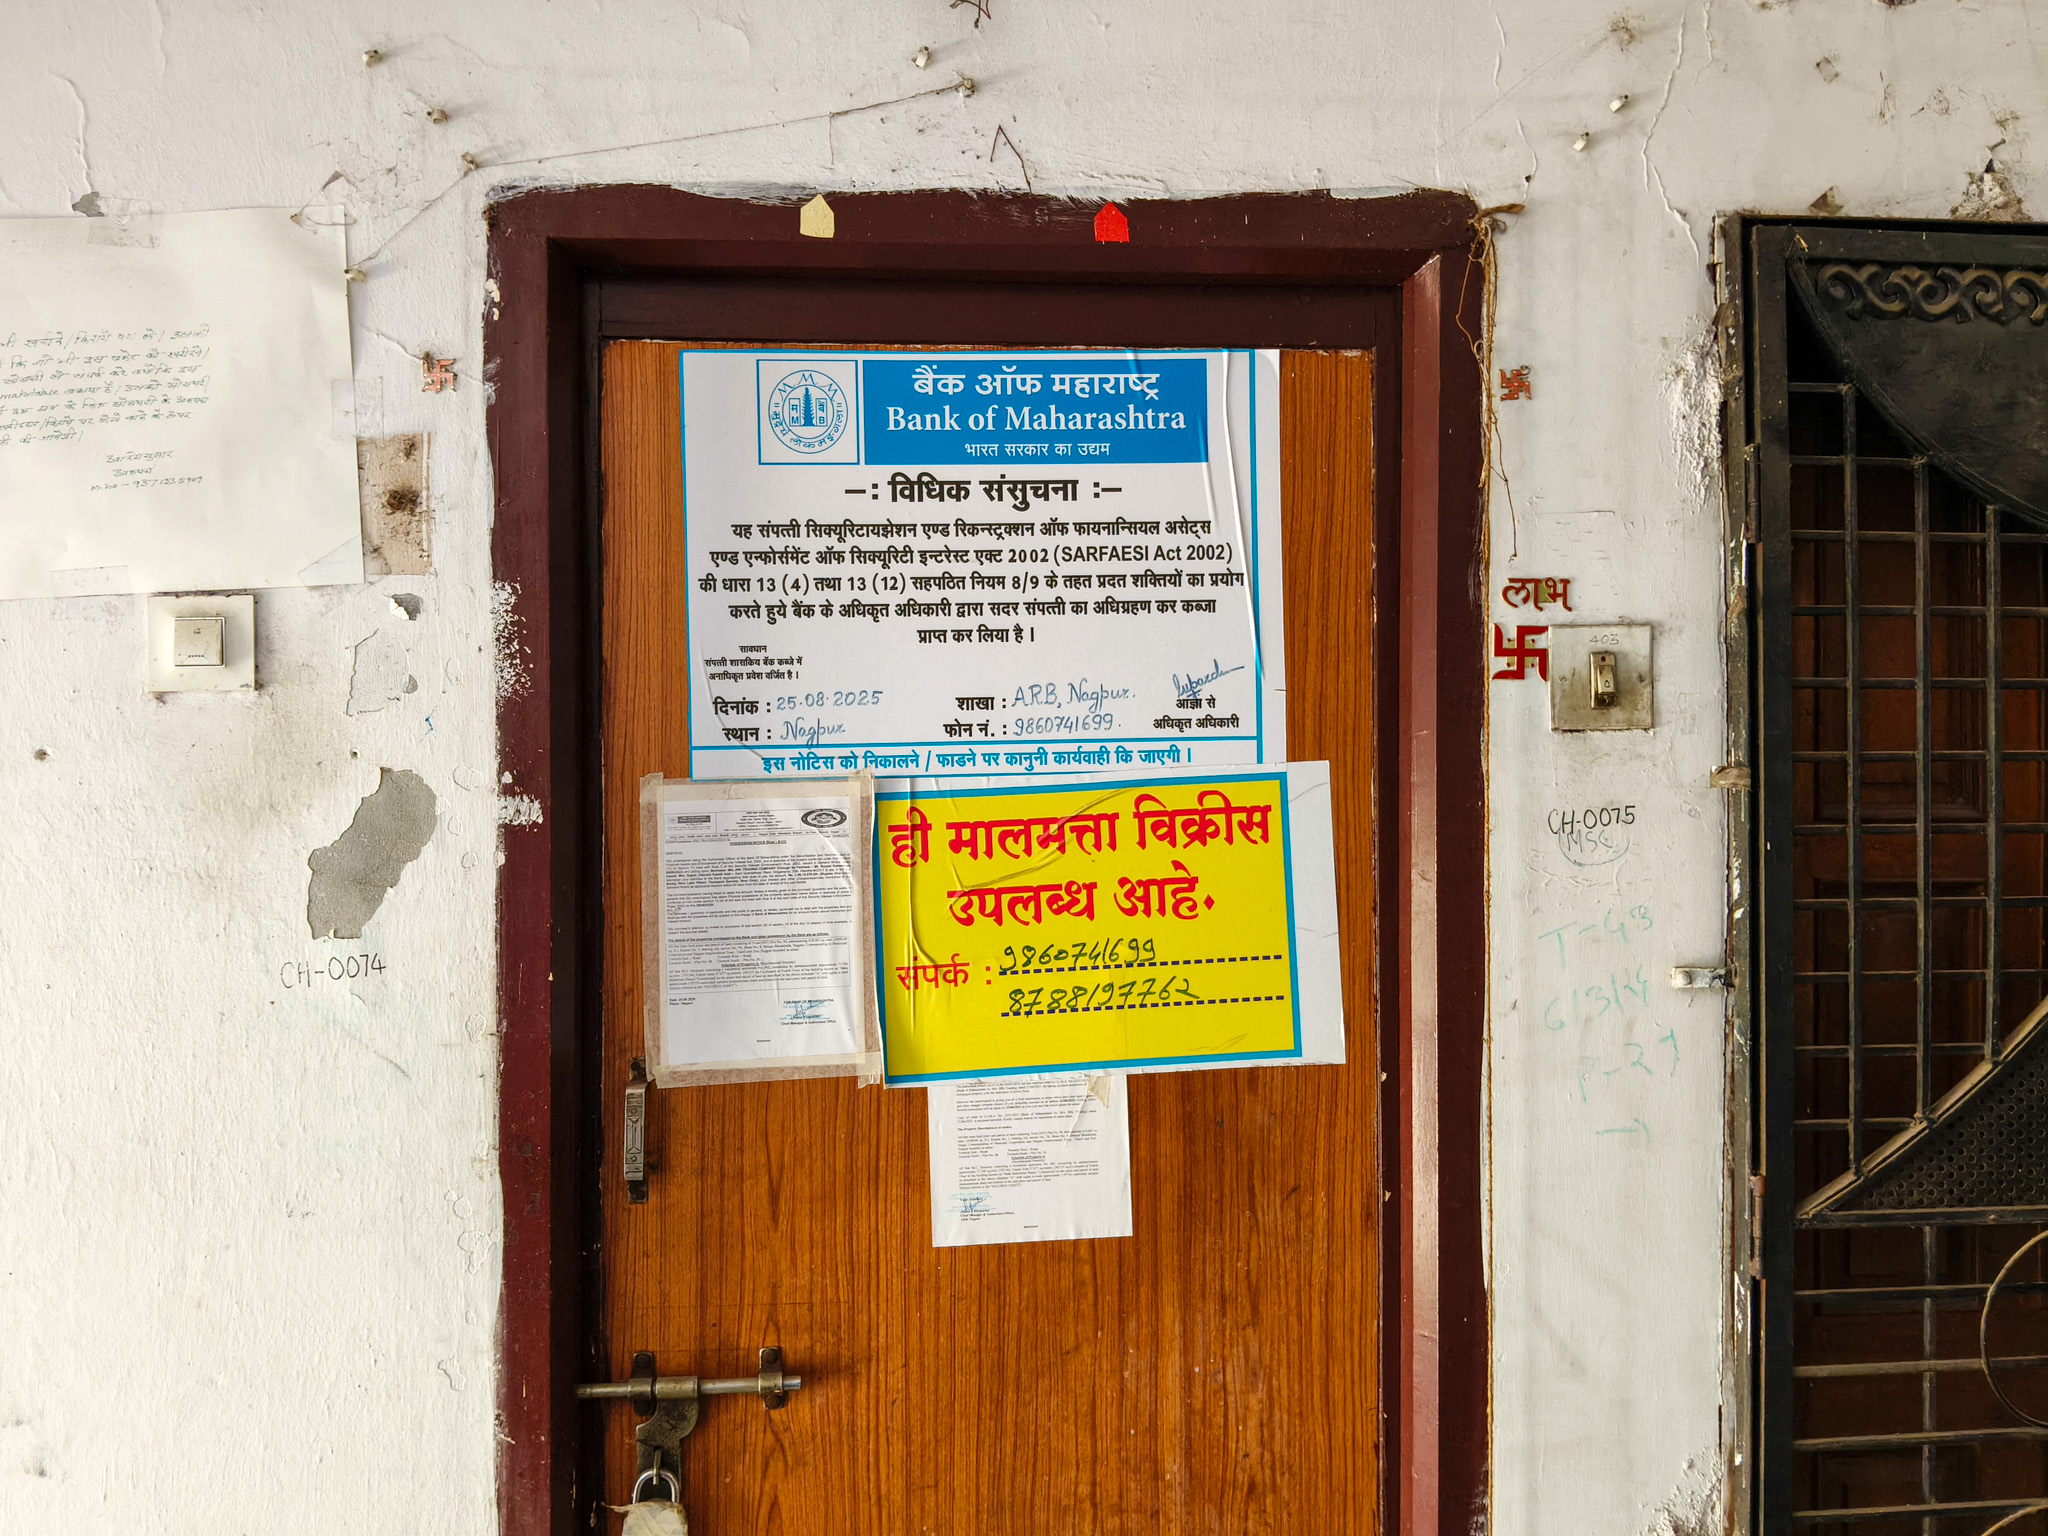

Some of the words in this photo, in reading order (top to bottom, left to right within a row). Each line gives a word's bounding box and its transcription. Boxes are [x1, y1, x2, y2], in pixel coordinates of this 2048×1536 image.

[911, 365, 965, 397] बैंक
[974, 364, 1040, 396] ऑफ
[1050, 371, 1160, 401] महाराष्ट्र
[818, 416, 825, 424] B
[886, 407, 963, 433] Bank
[967, 406, 999, 432] of
[1004, 406, 1187, 432] Maharashtra
[965, 442, 1002, 458] भारत
[1004, 444, 1050, 458] सरकार
[1054, 444, 1074, 457] का
[1077, 443, 1111, 459] उद्यम
[887, 473, 970, 503] विधिक
[979, 475, 1078, 512] संसुचना
[731, 522, 753, 539] यह
[758, 519, 801, 538] संपत्ती
[805, 518, 917, 543] सिक्यूरिटायझेशन
[921, 523, 951, 538] एण्ड
[1039, 517, 1069, 537] ऑफ
[1072, 516, 1160, 537] फायनान्सियल
[1164, 515, 1212, 539] असेट्स
[709, 550, 739, 568] एण्ड
[743, 545, 811, 568] एन्फोर्समेंट
[815, 546, 846, 565] ऑफ
[850, 544, 914, 570] सिक्यूरिटी
[918, 545, 970, 566] इन्टरेस्ट
[973, 548, 1003, 566] एक्ट
[1007, 548, 1050, 563] 2002
[1053, 544, 1149, 567] (SARFAESI
[1153, 545, 1182, 561] Act
[1186, 542, 1234, 564] 2002)
[698, 572, 718, 592] की
[722, 576, 751, 592] धारा
[757, 577, 777, 592] 13
[781, 573, 810, 596] (4)
[813, 576, 842, 592] तथा
[847, 576, 867, 591] 13
[871, 572, 906, 595] (12)
[910, 571, 966, 591] सहपठित
[970, 570, 1006, 590] नियम
[1011, 571, 1040, 594] 8/9
[1043, 569, 1058, 589] के
[1062, 573, 1092, 590] तहत
[1131, 568, 1183, 588] शक्तियों
[1187, 571, 1205, 587] का
[1209, 567, 1245, 587] प्रयोग
[1502, 576, 1572, 612] लाभ
[728, 599, 761, 620] करते
[765, 599, 788, 624] हुये
[792, 599, 816, 619] बैंक
[820, 600, 834, 619] के
[838, 598, 890, 622] अधिकृत
[894, 597, 952, 618] अधिकारी
[955, 602, 984, 618] द्वारा
[988, 601, 1020, 617] सदर
[1023, 597, 1066, 616] संपत्ती
[1070, 600, 1089, 616] का
[1092, 595, 1152, 616] अधिग्रहण
[1155, 600, 1177, 614] कर
[1181, 599, 1217, 614] कब्जा
[916, 628, 948, 645] प्राप्त
[951, 628, 974, 644] कर
[977, 624, 1010, 643] लिया
[1013, 623, 1025, 644] है
[738, 644, 768, 654] सावधान
[708, 670, 745, 683] अनाधिकृत
[746, 670, 764, 681] प्रवेश
[765, 669, 786, 681] वर्जित
[713, 696, 760, 716] दिनांक
[955, 696, 995, 712] शाखा
[1205, 697, 1217, 710] से
[722, 726, 760, 742] स्थान
[943, 719, 973, 738] फोन
[1152, 717, 1193, 732] अधिकृत
[1195, 715, 1240, 729] अधिकारी
[762, 756, 785, 773] इस
[789, 751, 835, 770] नोटिस
[840, 751, 858, 770] को
[863, 748, 920, 769] निकालने
[936, 748, 977, 767] फाडने
[982, 751, 1001, 766] पर
[1005, 746, 1048, 772] कानुनी
[1053, 745, 1111, 766] कार्यवाही
[1115, 746, 1134, 764] कि
[1138, 744, 1181, 765] जाएगी
[888, 806, 933, 869] ही
[946, 812, 1120, 862] मालमत्ता
[1133, 790, 1272, 851] विक्रीस
[1547, 804, 1637, 836] CH-0075
[947, 879, 1098, 928] उपलब्ध
[1113, 859, 1217, 921] आहे.
[999, 937, 1157, 974] 9860741699
[280, 952, 387, 989] CH-0074
[896, 952, 970, 992] संपर्क
[1008, 975, 1201, 1019] 8788197762
